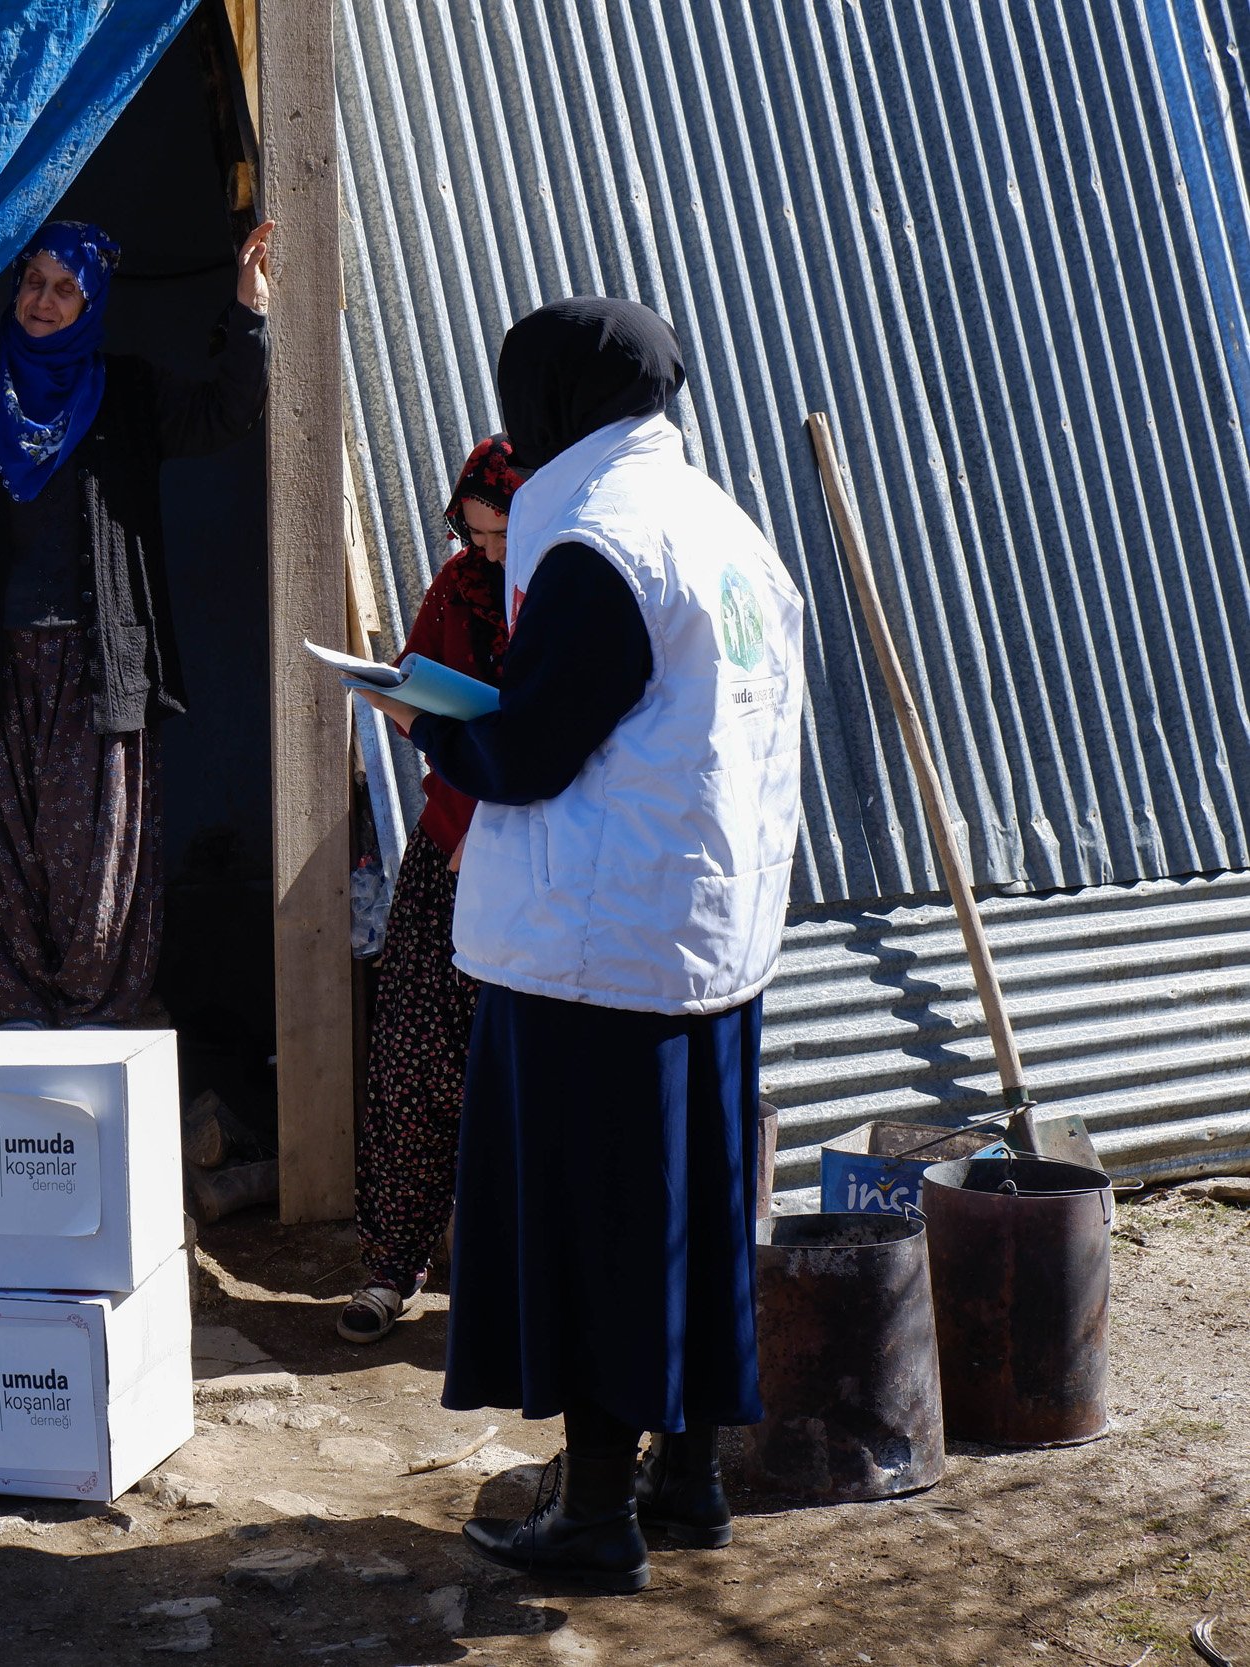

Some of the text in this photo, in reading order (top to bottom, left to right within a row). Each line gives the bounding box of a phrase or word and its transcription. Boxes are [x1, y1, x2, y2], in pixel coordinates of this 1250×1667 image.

[5, 1132, 75, 1154] umuda
[6, 1155, 77, 1180] koşanlar
[32, 1179, 76, 1194] derneği
[2, 1368, 69, 1390] umuda
[3, 1390, 71, 1415] koşanlar
[30, 1413, 72, 1430] derneği
